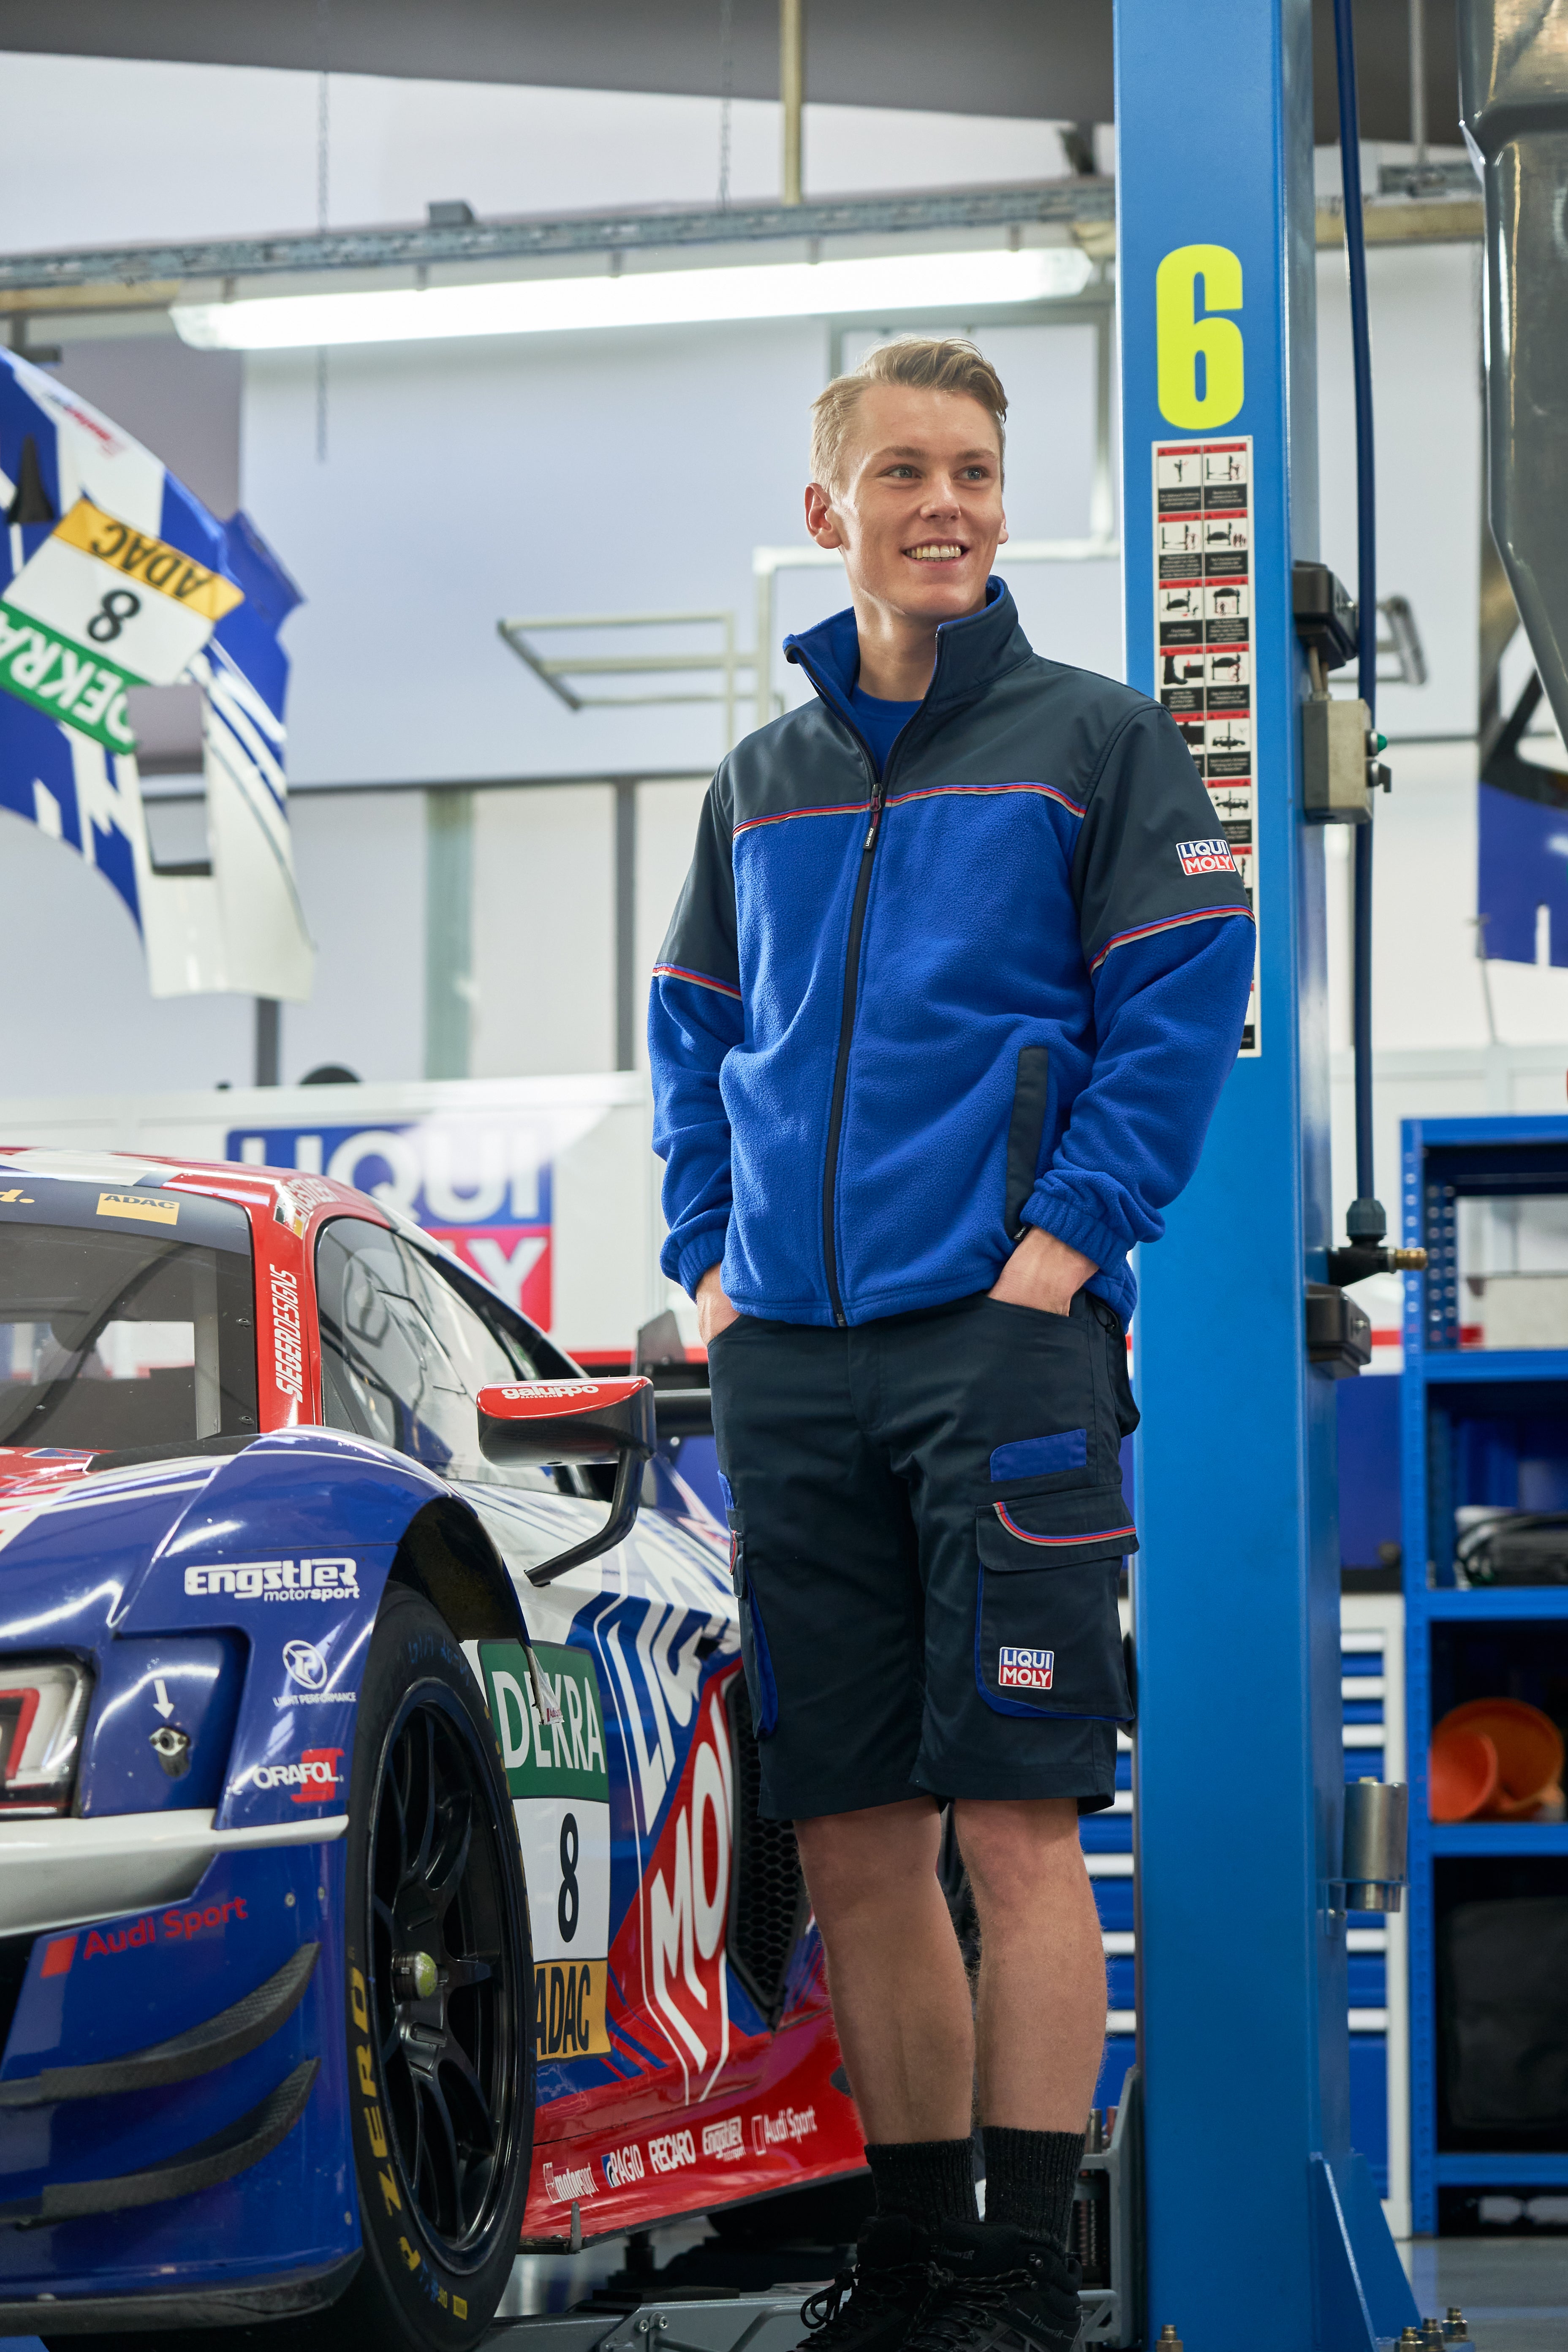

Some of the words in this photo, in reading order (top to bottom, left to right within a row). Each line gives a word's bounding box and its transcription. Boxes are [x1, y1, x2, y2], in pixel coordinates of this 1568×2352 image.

[1156, 244, 1244, 430] 6
[90, 522, 213, 599] ADAC
[87, 588, 141, 643] 8
[1180, 841, 1228, 858] LIQUI
[1185, 856, 1231, 873] MOLY
[104, 1195, 176, 1209] ADAC
[269, 1263, 303, 1403] SIEGERDESIGNS
[501, 1385, 599, 1400] galuppo
[264, 1585, 360, 1602] motorsport
[1003, 1667, 1051, 1686] MOLY
[1004, 1650, 1050, 1669] LIQUI
[299, 1692, 356, 1705] PERFORMANCE
[492, 1671, 606, 1774] DEKRA
[253, 1761, 340, 1789] ORAFOL
[558, 1813, 579, 1943] 8
[83, 1917, 155, 1960] Audi
[163, 1896, 248, 1939] Sport
[535, 1964, 590, 2055] ADAC
[350, 1967, 402, 2216] ZERO
[764, 2109, 789, 2144] Audi
[787, 2105, 818, 2144] Sport
[648, 2129, 696, 2174] RECARO
